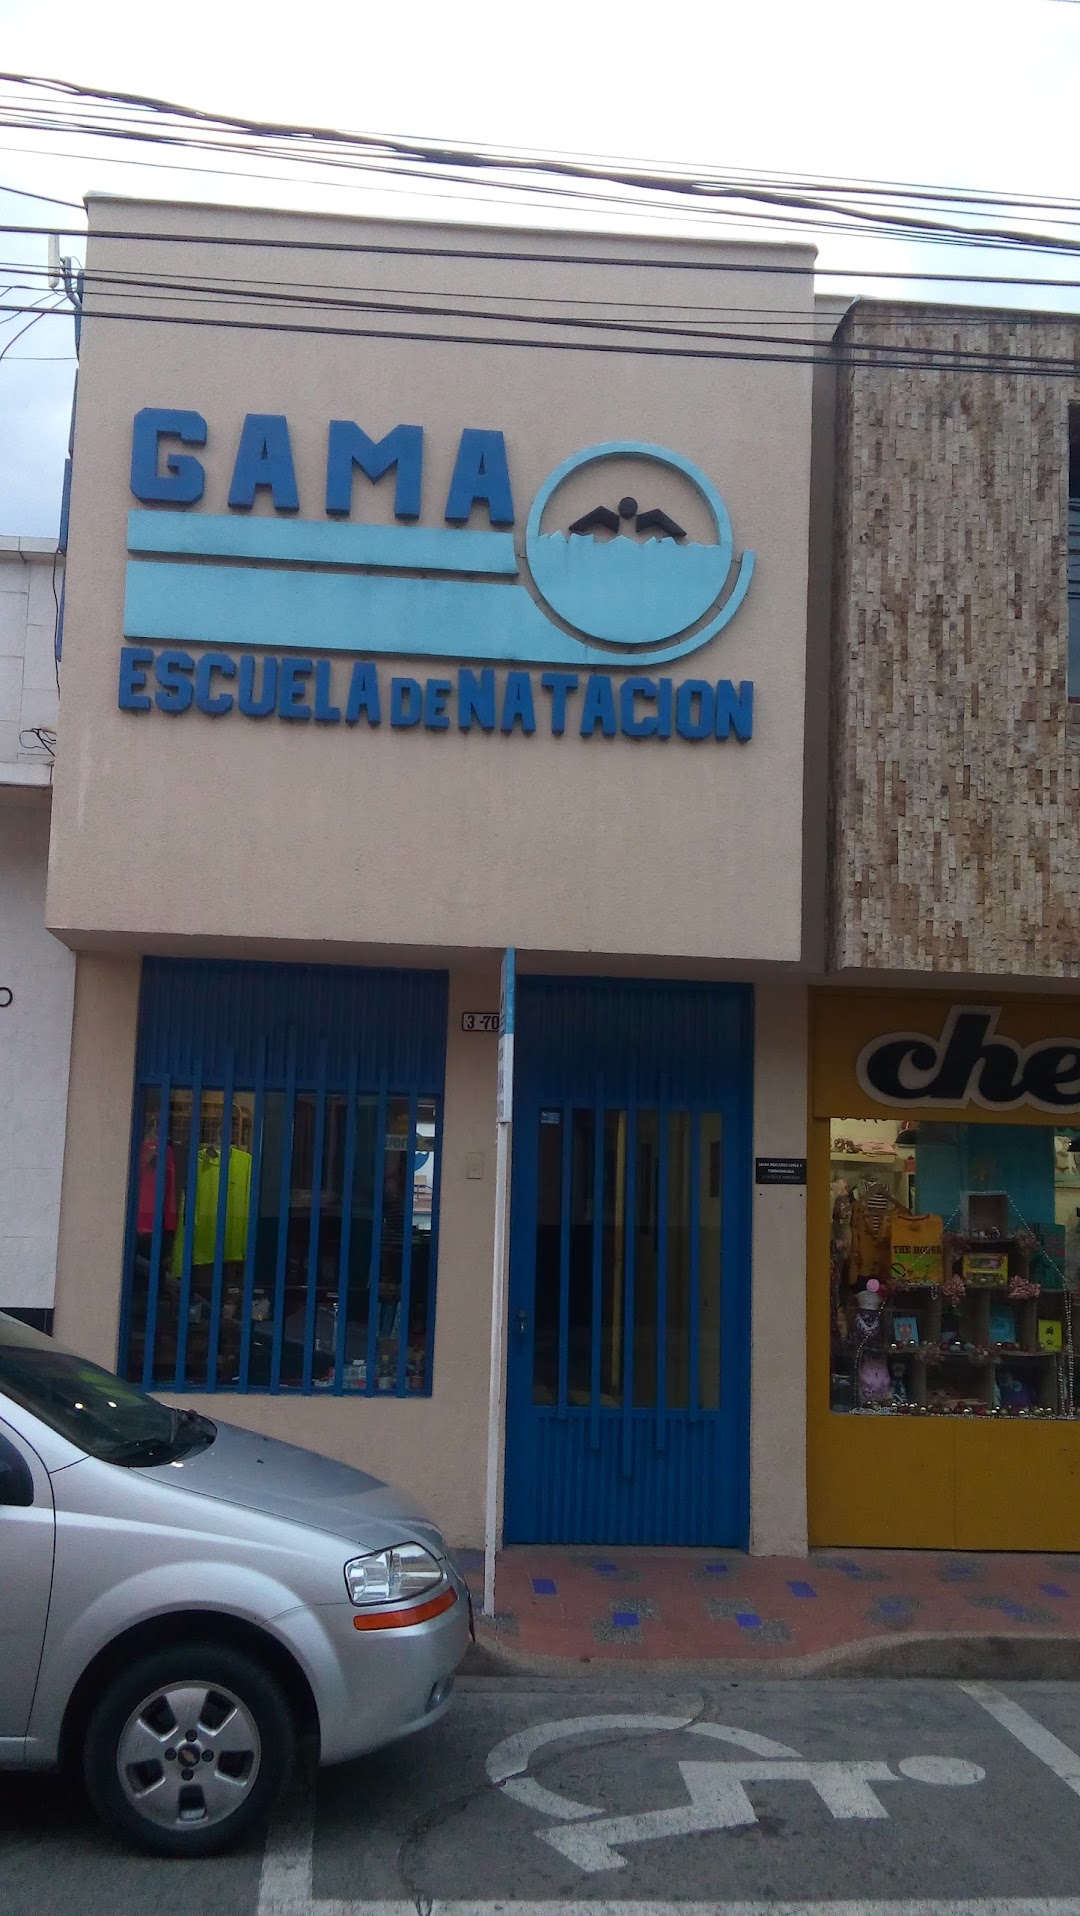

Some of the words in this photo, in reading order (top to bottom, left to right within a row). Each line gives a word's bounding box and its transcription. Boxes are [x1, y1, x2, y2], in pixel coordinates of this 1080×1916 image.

[130, 407, 515, 526] GAMA
[118, 647, 381, 725] ESCUELA
[390, 677, 450, 730] DE
[457, 668, 754, 742] NATACION
[893, 1245, 911, 1254] THE
